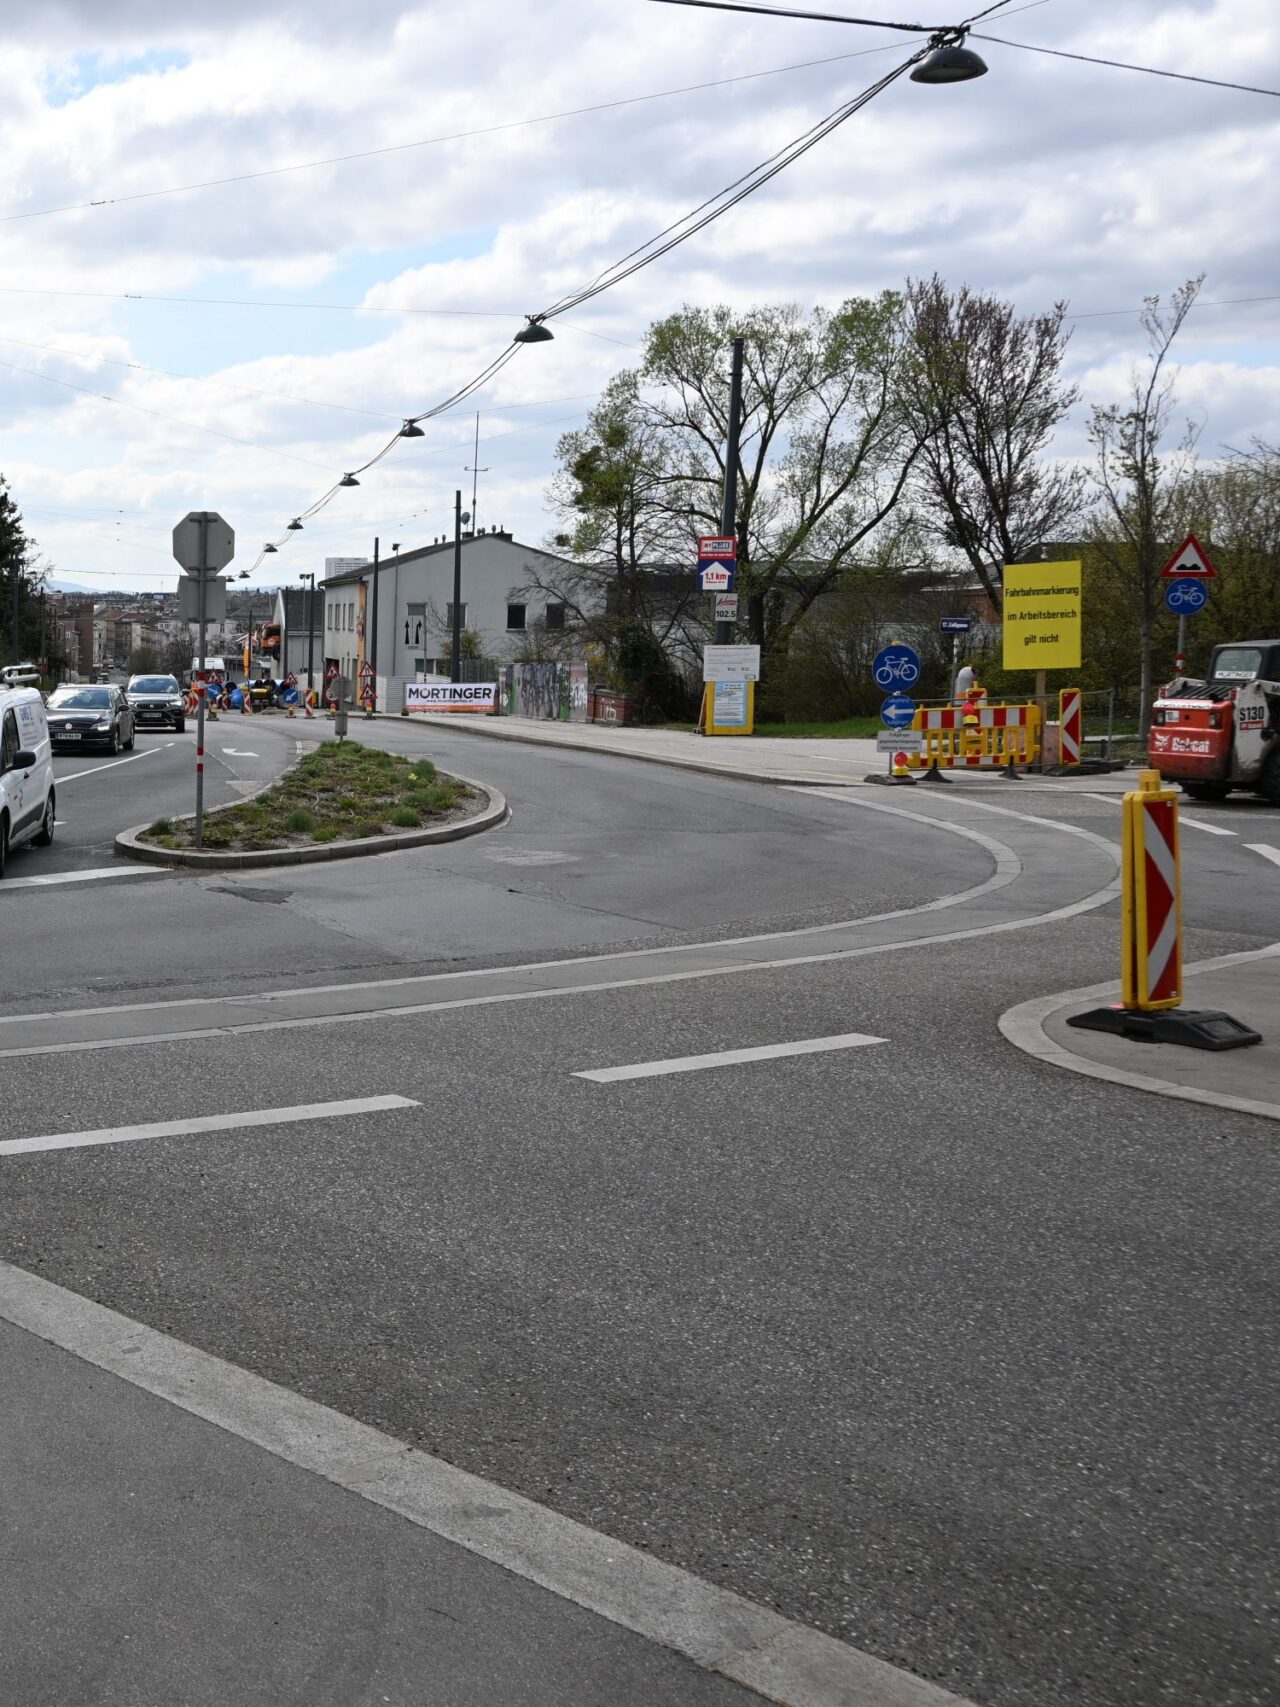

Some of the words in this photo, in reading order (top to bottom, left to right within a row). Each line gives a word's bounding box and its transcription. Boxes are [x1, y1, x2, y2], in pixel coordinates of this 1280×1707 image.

[1005, 586, 1079, 597] Fahrbahnmarkierung
[1007, 612, 1017, 620] im
[1019, 609, 1077, 620] Arbeitsbereich
[1024, 635, 1037, 646] gilt
[1039, 634, 1059, 643] nicht
[1240, 706, 1265, 721] S130
[1171, 737, 1210, 753] Bobcat
